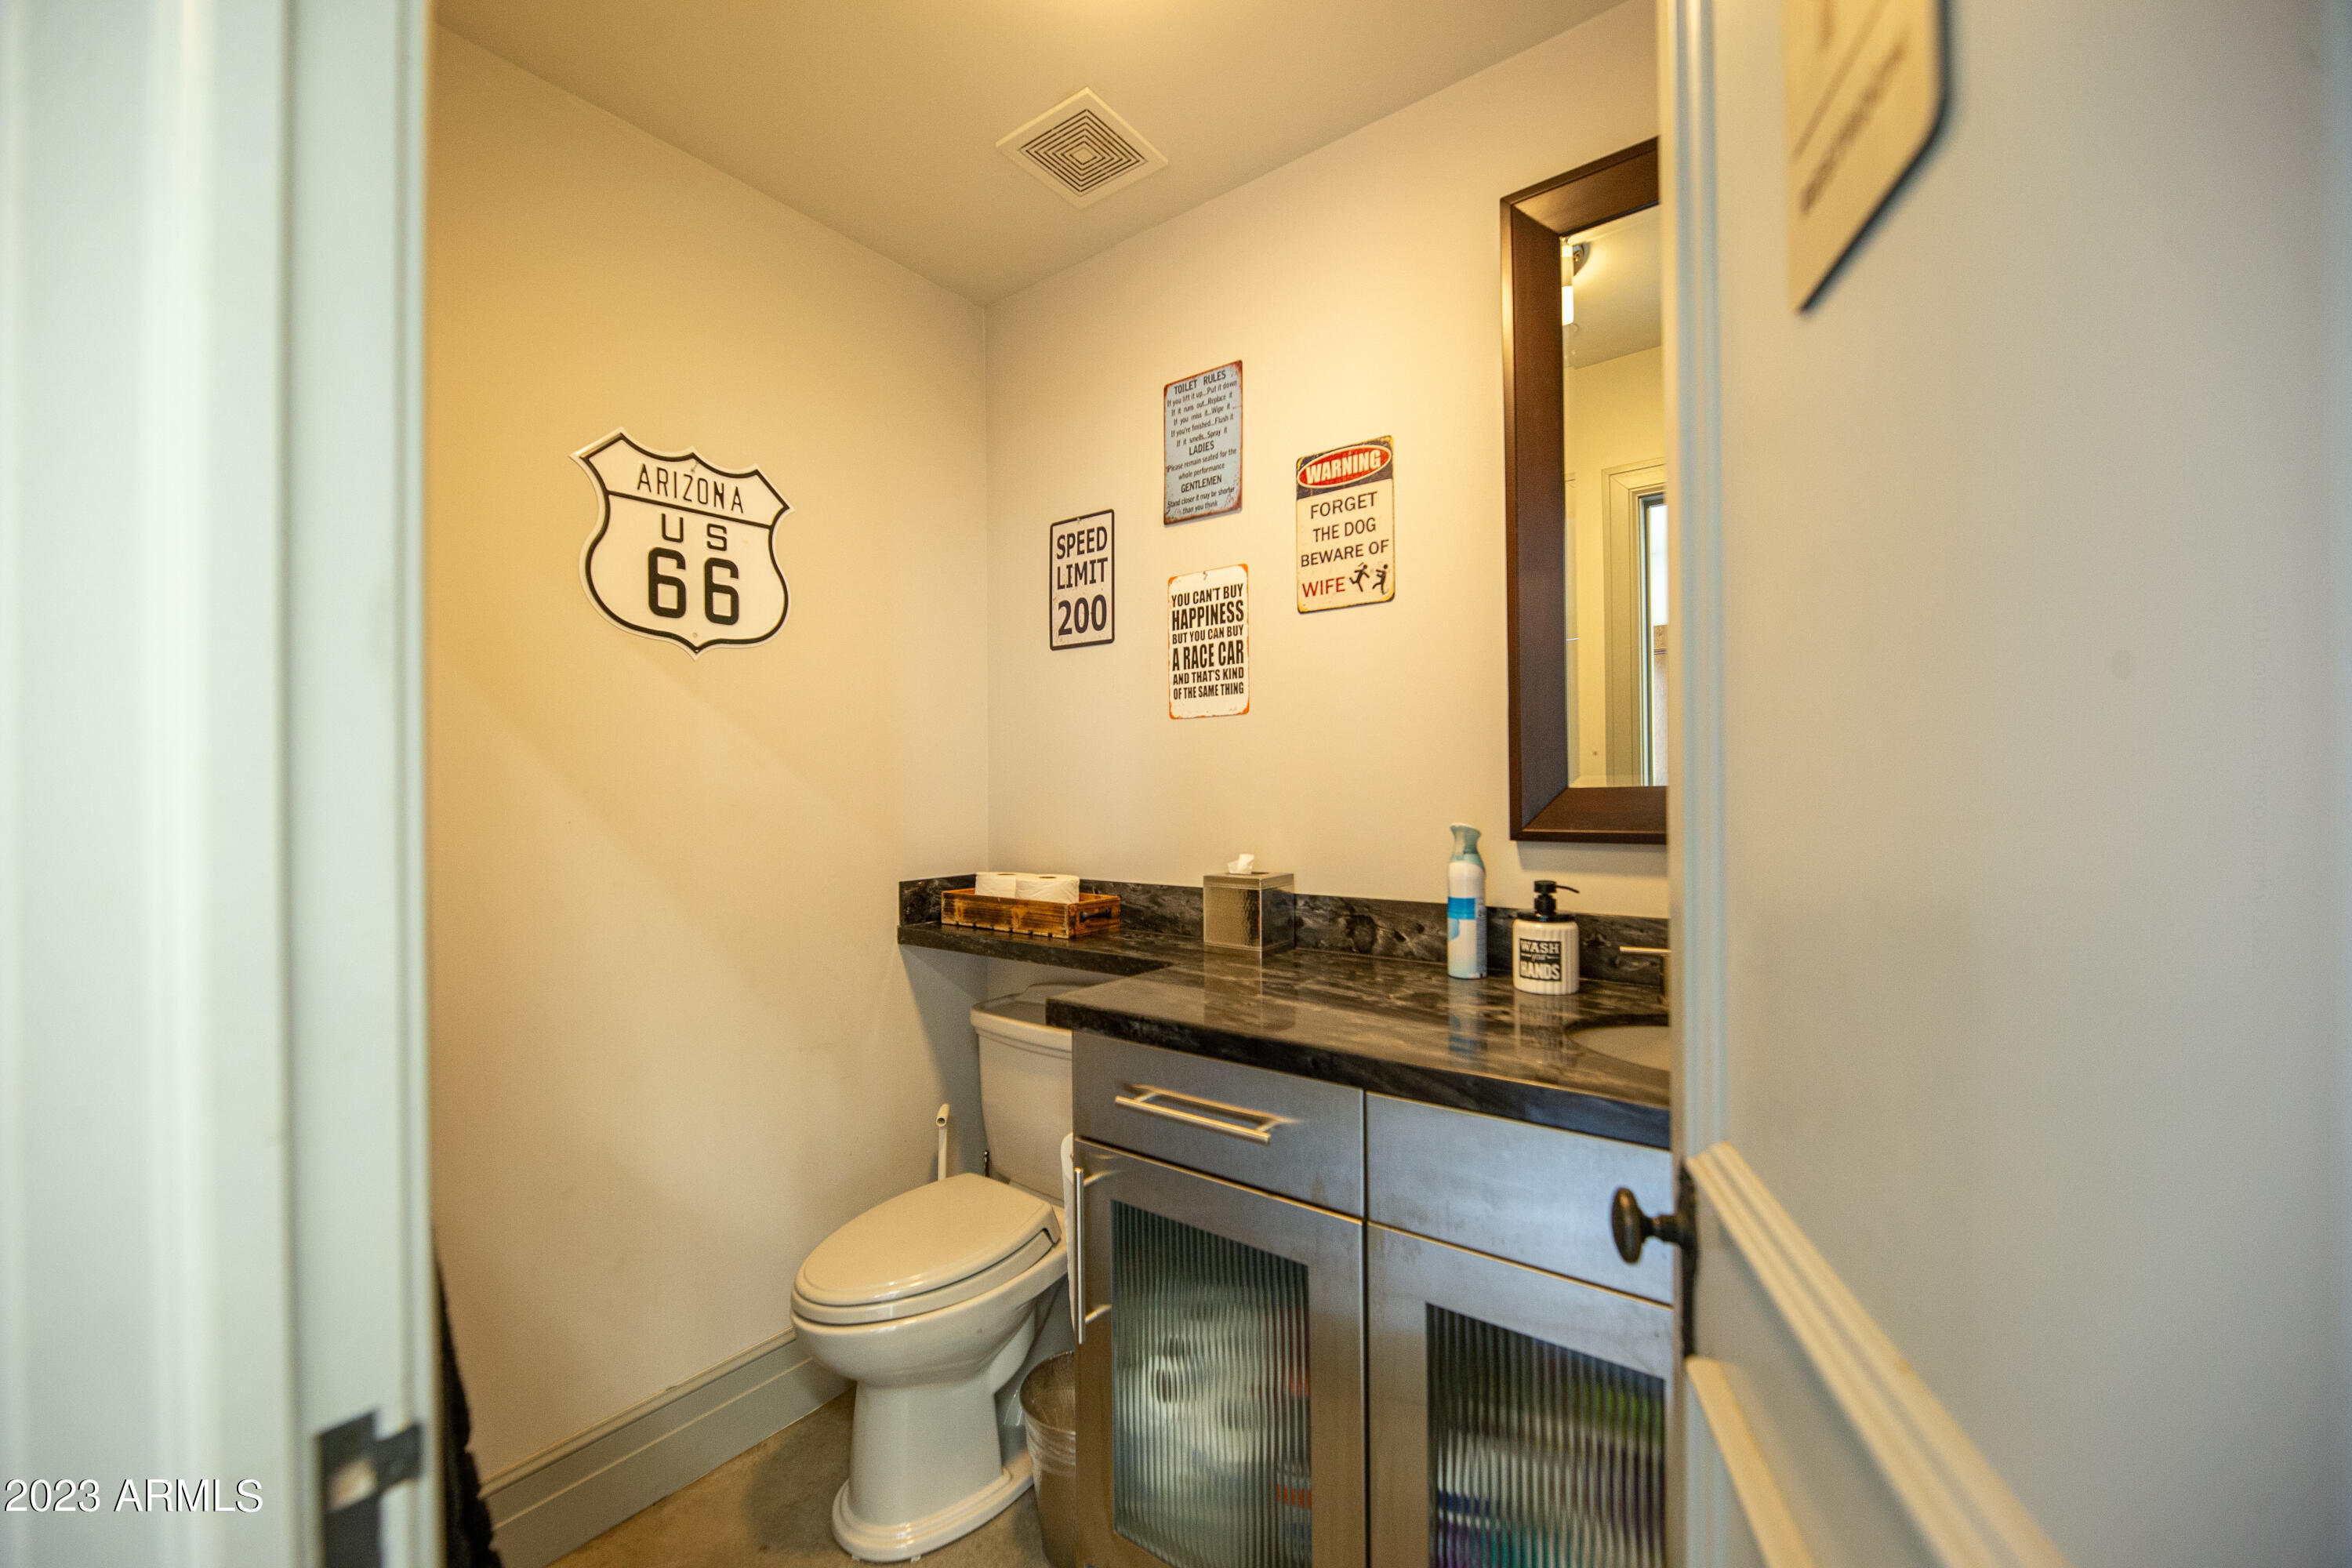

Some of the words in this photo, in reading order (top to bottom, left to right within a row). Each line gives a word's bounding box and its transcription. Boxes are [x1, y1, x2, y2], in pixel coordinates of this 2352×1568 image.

[1174, 379, 1197, 394] TOILET
[1203, 370, 1225, 385] RULES
[1177, 427, 1190, 437] you're
[1189, 441, 1214, 455] LADIES
[1167, 463, 1183, 472] Please
[1185, 459, 1201, 467] remain
[1203, 452, 1218, 462] seated
[1194, 463, 1225, 477] performance
[1306, 449, 1381, 485] WARNING
[637, 464, 743, 514] ARIZONA
[1181, 474, 1221, 492] GENTLEMEN
[1311, 491, 1377, 519] FORGET
[1312, 524, 1340, 542] THE
[1345, 517, 1376, 536] DOG
[1057, 526, 1108, 559] SPEED
[1301, 543, 1363, 568] BEWARE
[1369, 539, 1389, 554] OF
[648, 546, 739, 625] 66
[1057, 557, 1108, 590] LIMIT
[1172, 593, 1190, 608] YOU
[1193, 586, 1221, 604] CAN'T
[1223, 583, 1243, 599] BUY
[1302, 576, 1345, 597] WIFE
[1058, 594, 1107, 636] 200
[1172, 600, 1244, 631] HAPPINESS
[1172, 633, 1187, 644] BUT
[1189, 630, 1205, 642] YOU
[1208, 626, 1224, 639] CAN
[1227, 625, 1243, 637] BUY
[1172, 648, 1179, 671] A
[1183, 643, 1214, 670] RACE
[1218, 640, 1243, 666] CAR
[1173, 673, 1189, 685] AND
[1192, 670, 1220, 683] THAT'S
[1223, 667, 1243, 681] KIND
[1173, 688, 1181, 700] OF
[1183, 686, 1196, 699] THE
[1198, 684, 1218, 698] SAME
[1220, 682, 1243, 695] THING
[1520, 940, 1560, 954] WASH
[1520, 961, 1560, 980] HANDS
